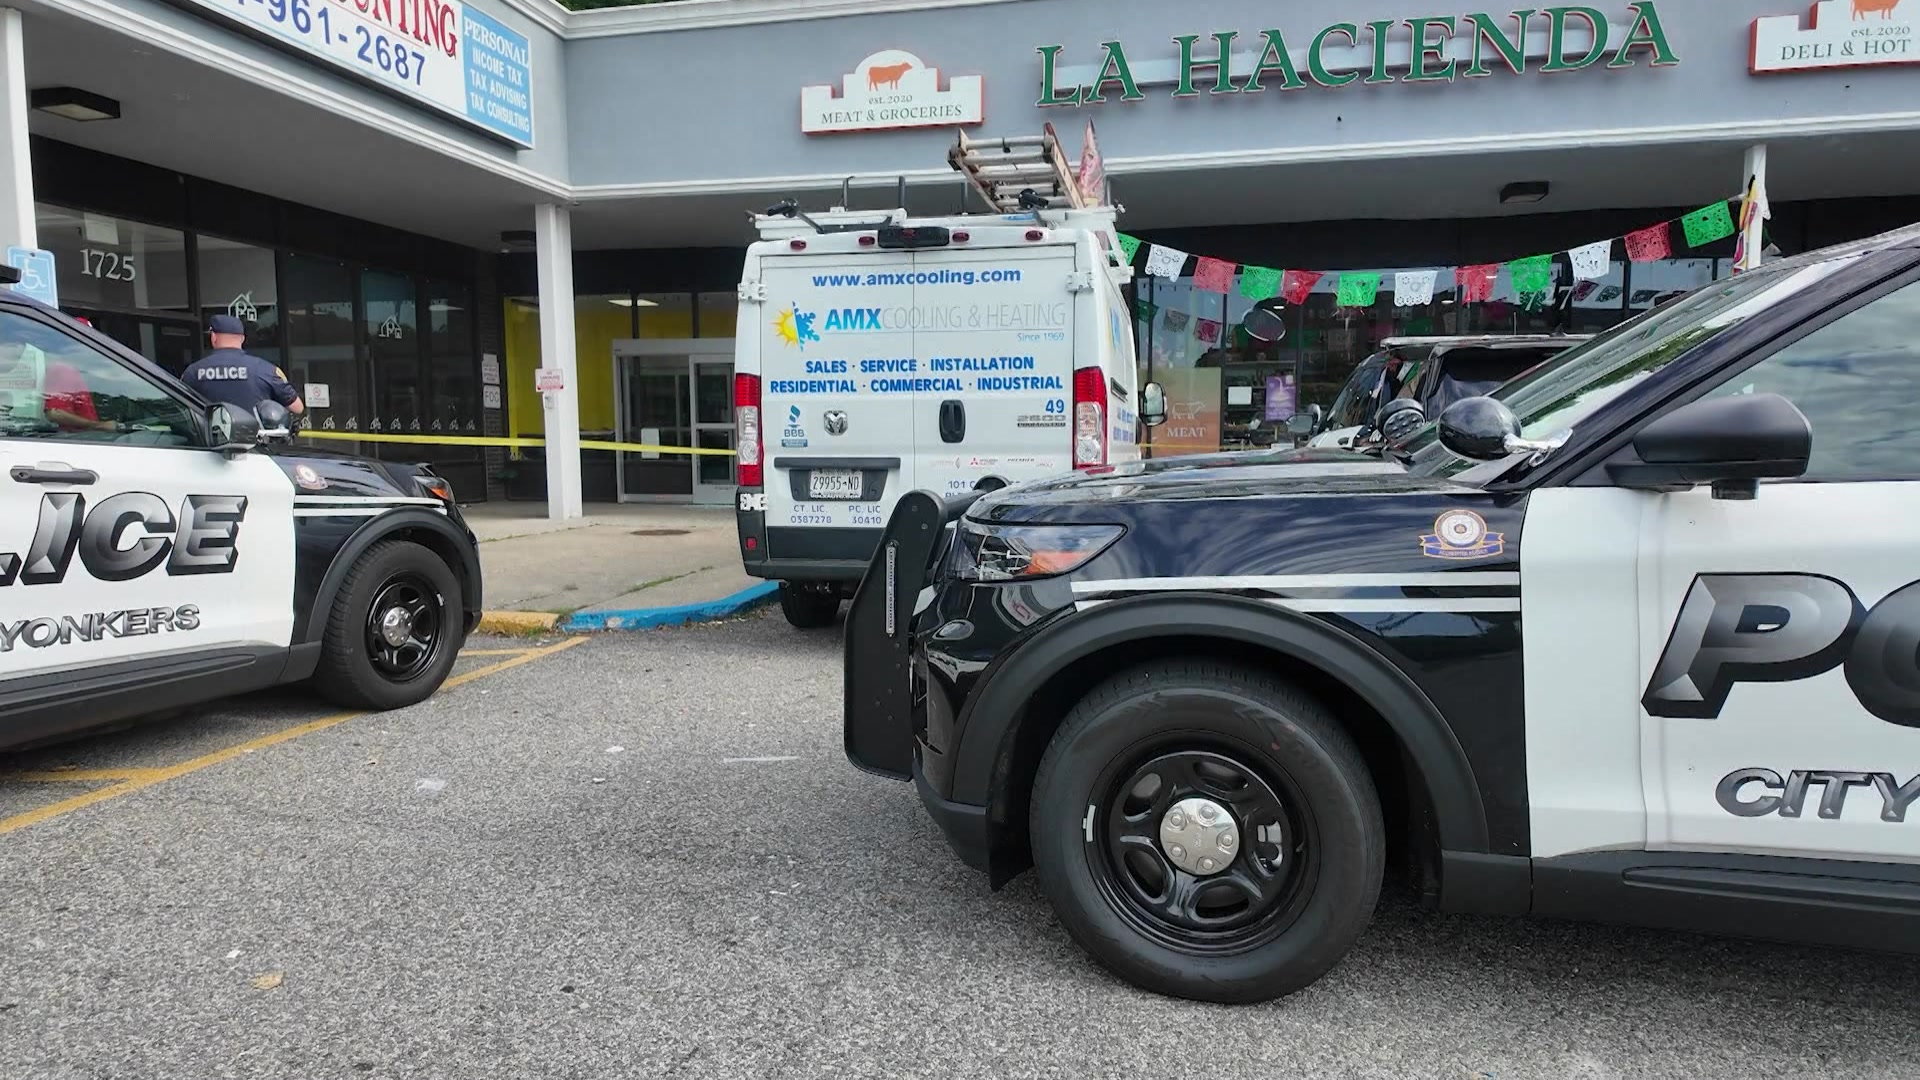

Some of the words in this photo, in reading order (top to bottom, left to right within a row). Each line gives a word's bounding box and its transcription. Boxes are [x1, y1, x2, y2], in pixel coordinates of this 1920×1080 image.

[464, 16, 528, 68] PERSONAL
[1851, 28, 1873, 38] est.
[1877, 26, 1911, 37] 2020
[1036, 41, 1146, 108] LA
[1171, 0, 1681, 98] HACIENDA
[1781, 43, 1832, 60] DELI
[1840, 41, 1854, 56] &
[1864, 39, 1911, 54] HOT
[472, 47, 505, 78] INCOME
[506, 65, 523, 87] TAX
[470, 68, 488, 92] TAX
[490, 80, 527, 110] ADVISING
[868, 97, 885, 105] est.
[887, 94, 913, 105] 2020
[470, 92, 485, 113] TAX
[487, 100, 529, 132] CONSULTING
[821, 111, 863, 124] MEAT
[866, 109, 876, 121] &
[880, 104, 963, 121] GROCERIES
[80, 248, 136, 282] 1725
[813, 269, 1021, 286] www.amxcooling.com
[968, 305, 981, 328] &
[986, 303, 1066, 328] HEATING
[1017, 333, 1040, 341] Since
[197, 366, 248, 381] POLICE
[806, 360, 847, 373] SALES
[860, 359, 917, 372] SERVICE
[930, 356, 1034, 371] INSTALLATION
[770, 379, 857, 393] RESIDENTIAL
[871, 377, 963, 392] COMMERCIAL
[977, 376, 1063, 390] INDUSTRIAL
[1045, 399, 1065, 413] 49
[784, 428, 805, 437] BBB
[1167, 427, 1206, 438] MEAT
[948, 480, 965, 489] 101
[0, 491, 248, 585] ICE
[0, 604, 200, 651] YONKERS
[1715, 767, 1920, 823] CITY
